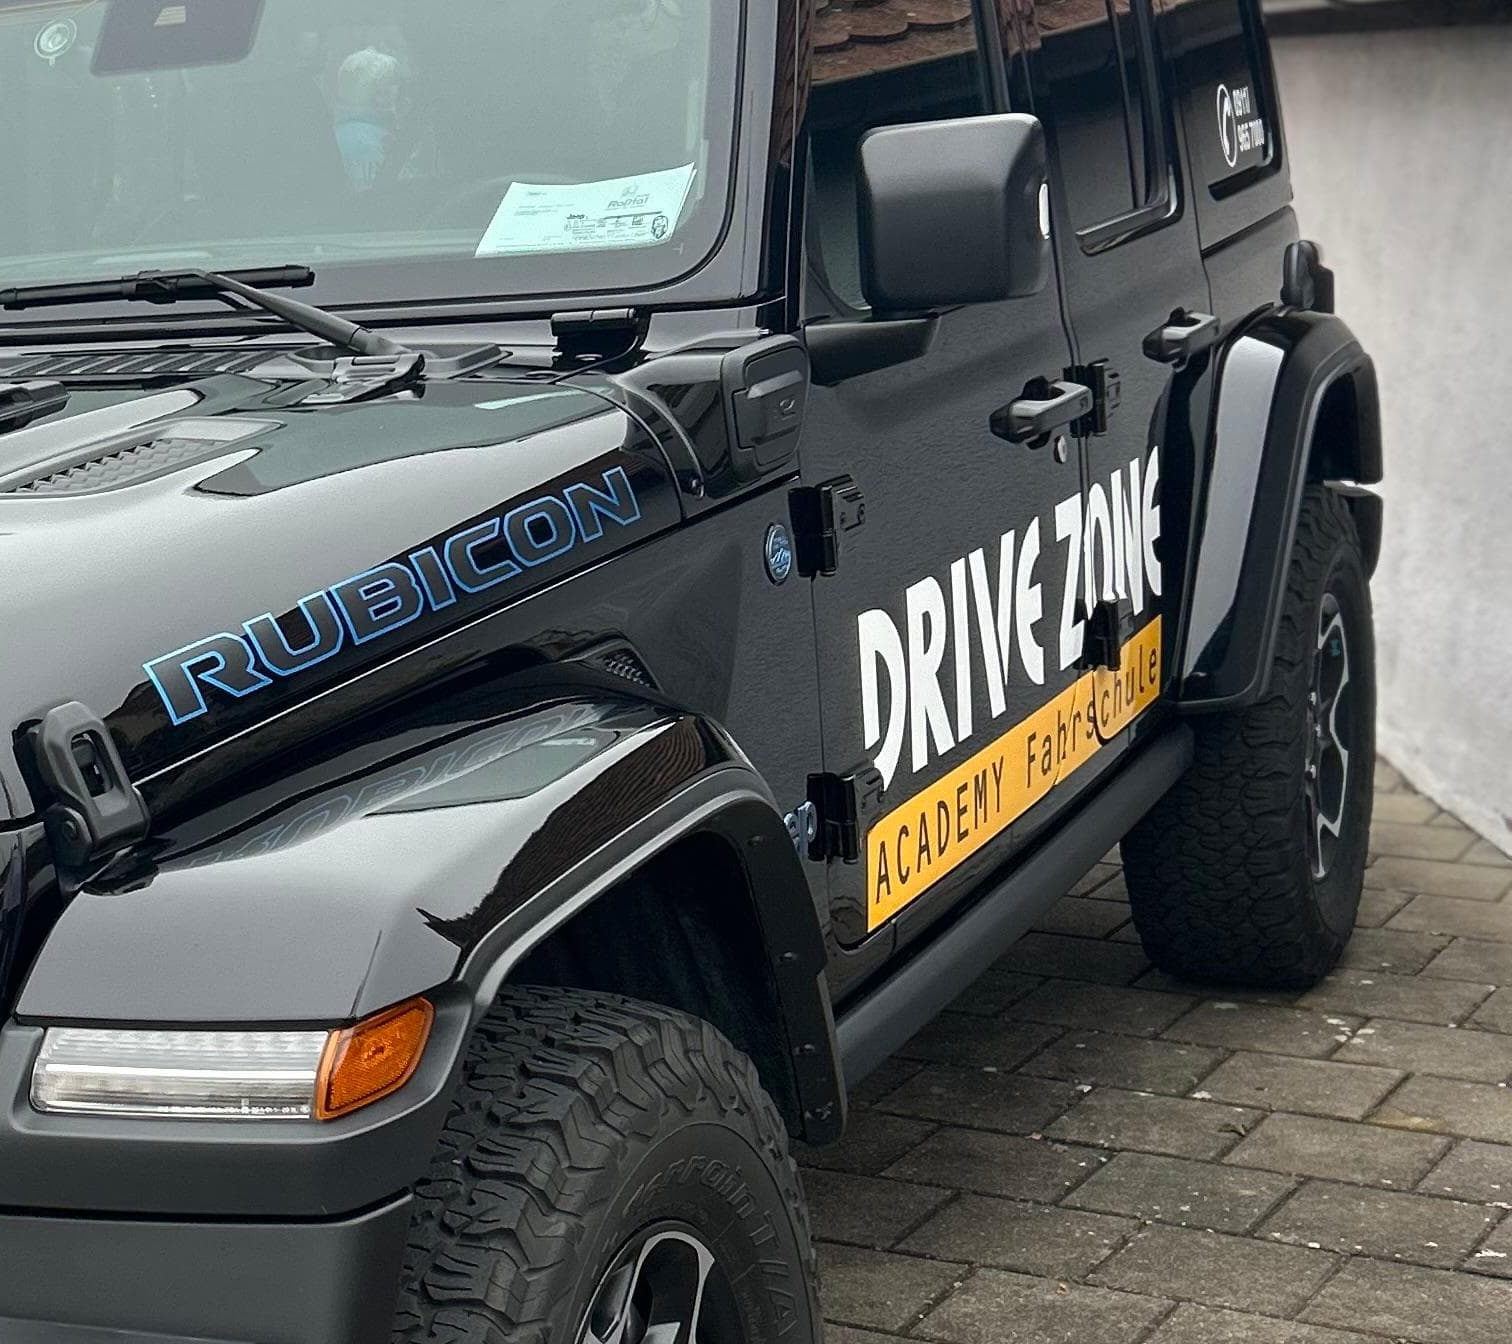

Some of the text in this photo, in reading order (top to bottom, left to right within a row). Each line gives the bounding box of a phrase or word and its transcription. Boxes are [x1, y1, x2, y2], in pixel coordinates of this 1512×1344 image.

[143, 466, 642, 726] RUBICON
[857, 445, 1162, 792] DRIVE ZONE
[874, 644, 1157, 904] ACADEMY Fahrschule
